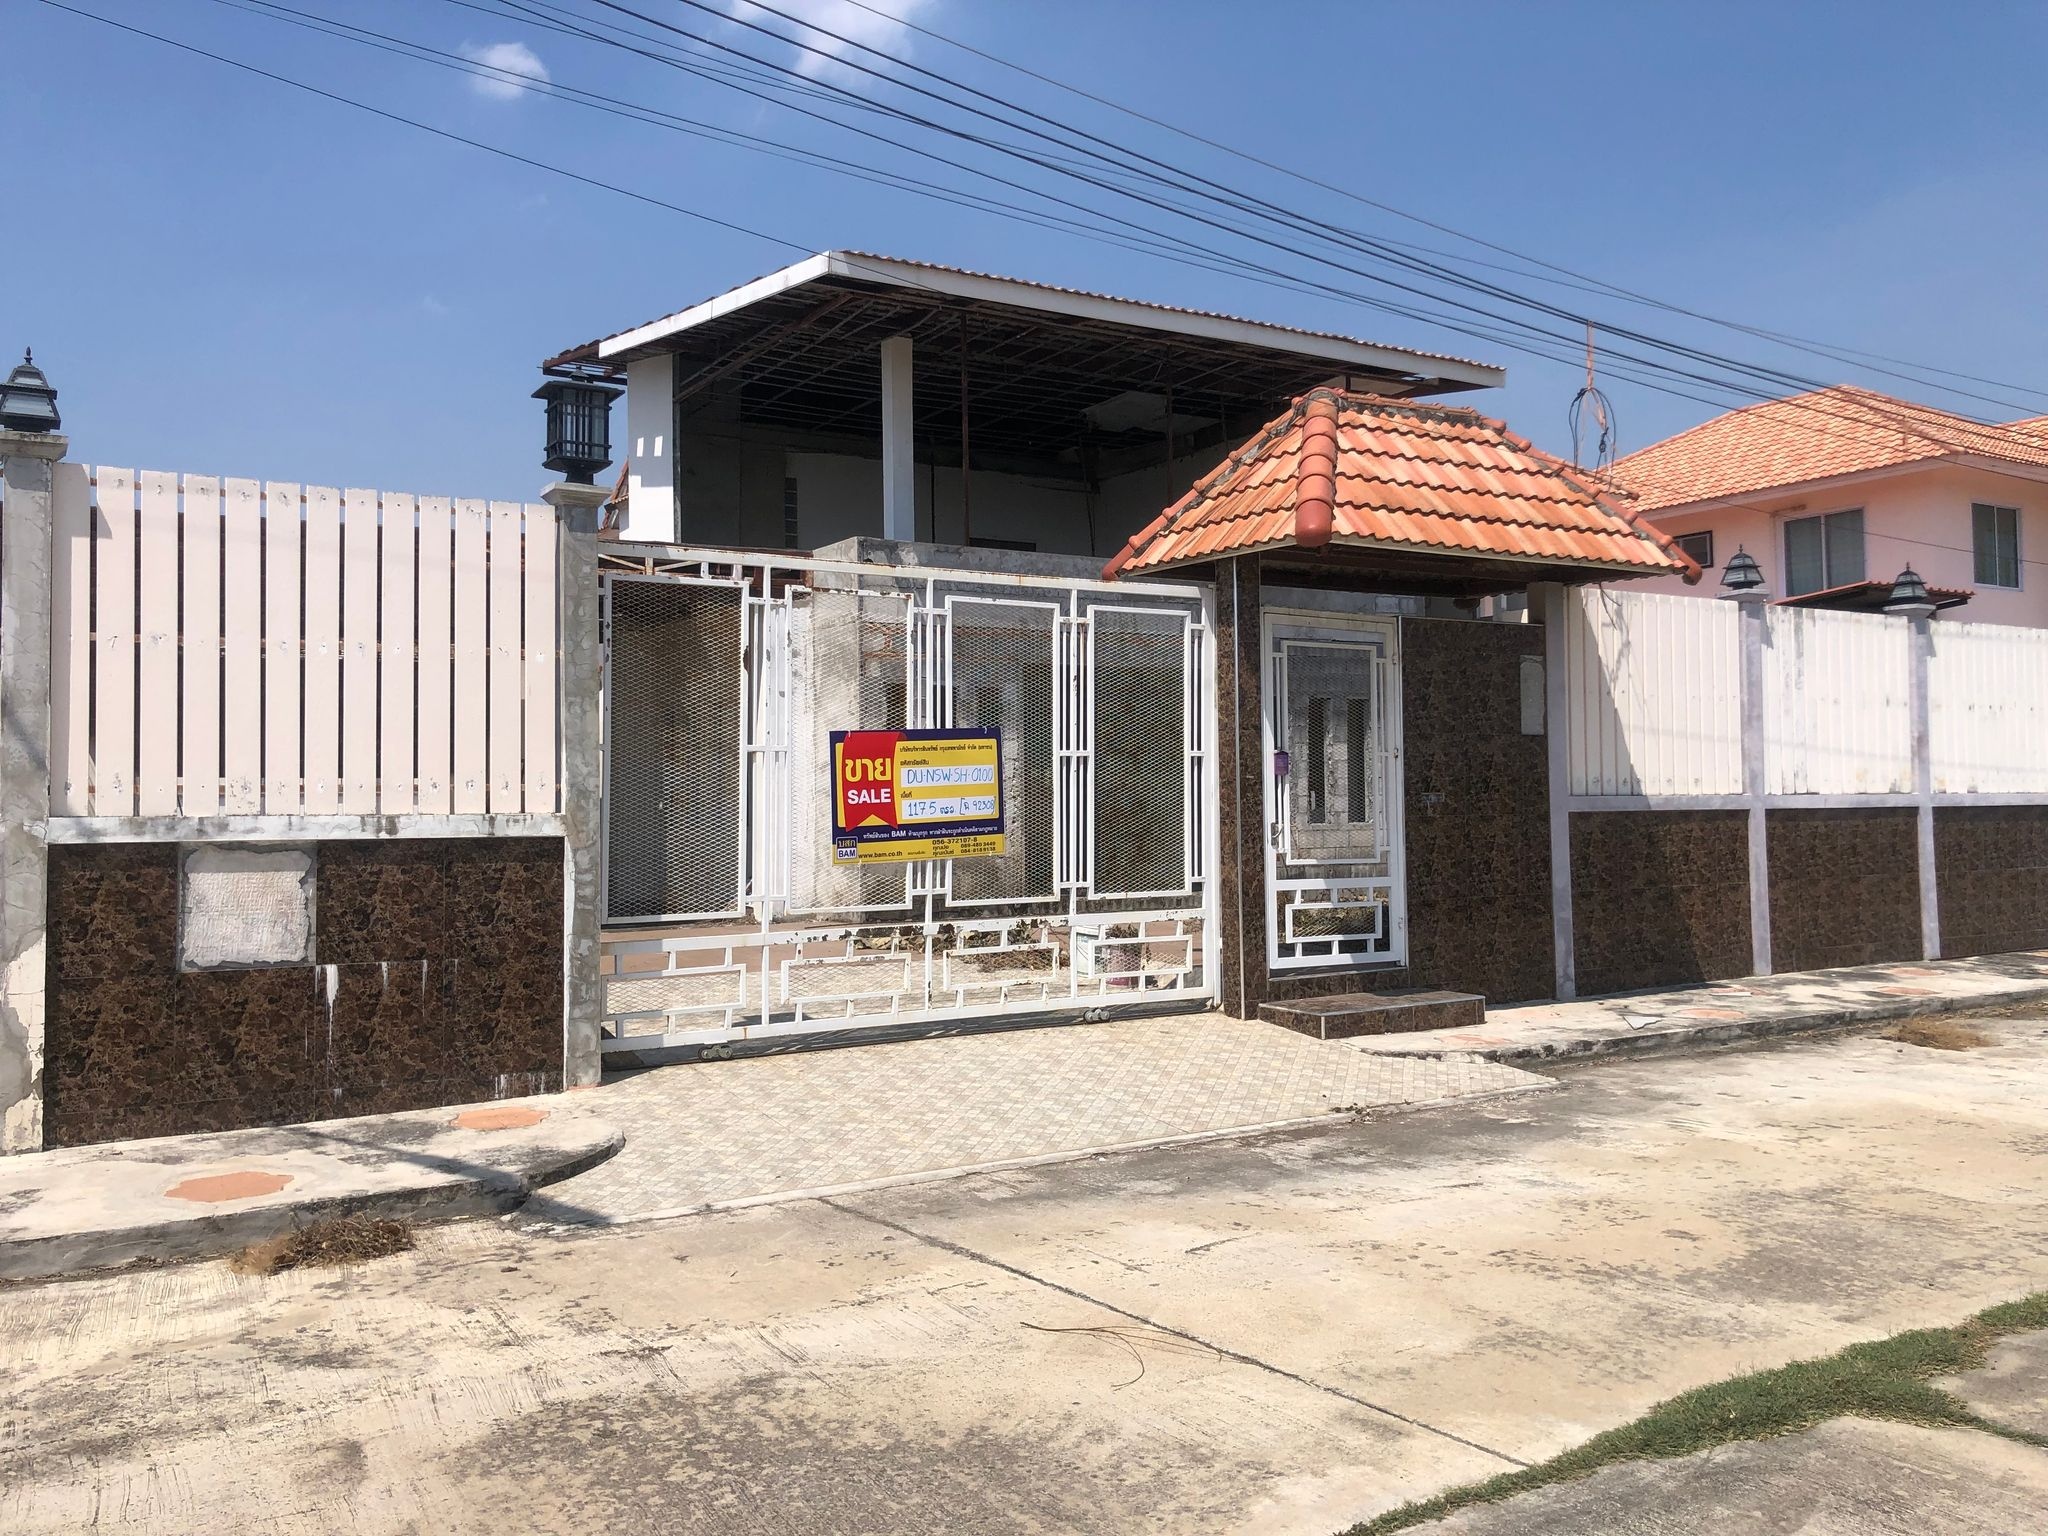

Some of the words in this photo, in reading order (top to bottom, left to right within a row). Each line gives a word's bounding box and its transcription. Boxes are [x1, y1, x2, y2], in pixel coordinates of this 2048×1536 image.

[845, 758, 892, 782] ขาย
[847, 789, 891, 805] SALE
[891, 830, 906, 838] BAM
[838, 849, 856, 858] BAM
[858, 851, 903, 859] www.bam.co.th
